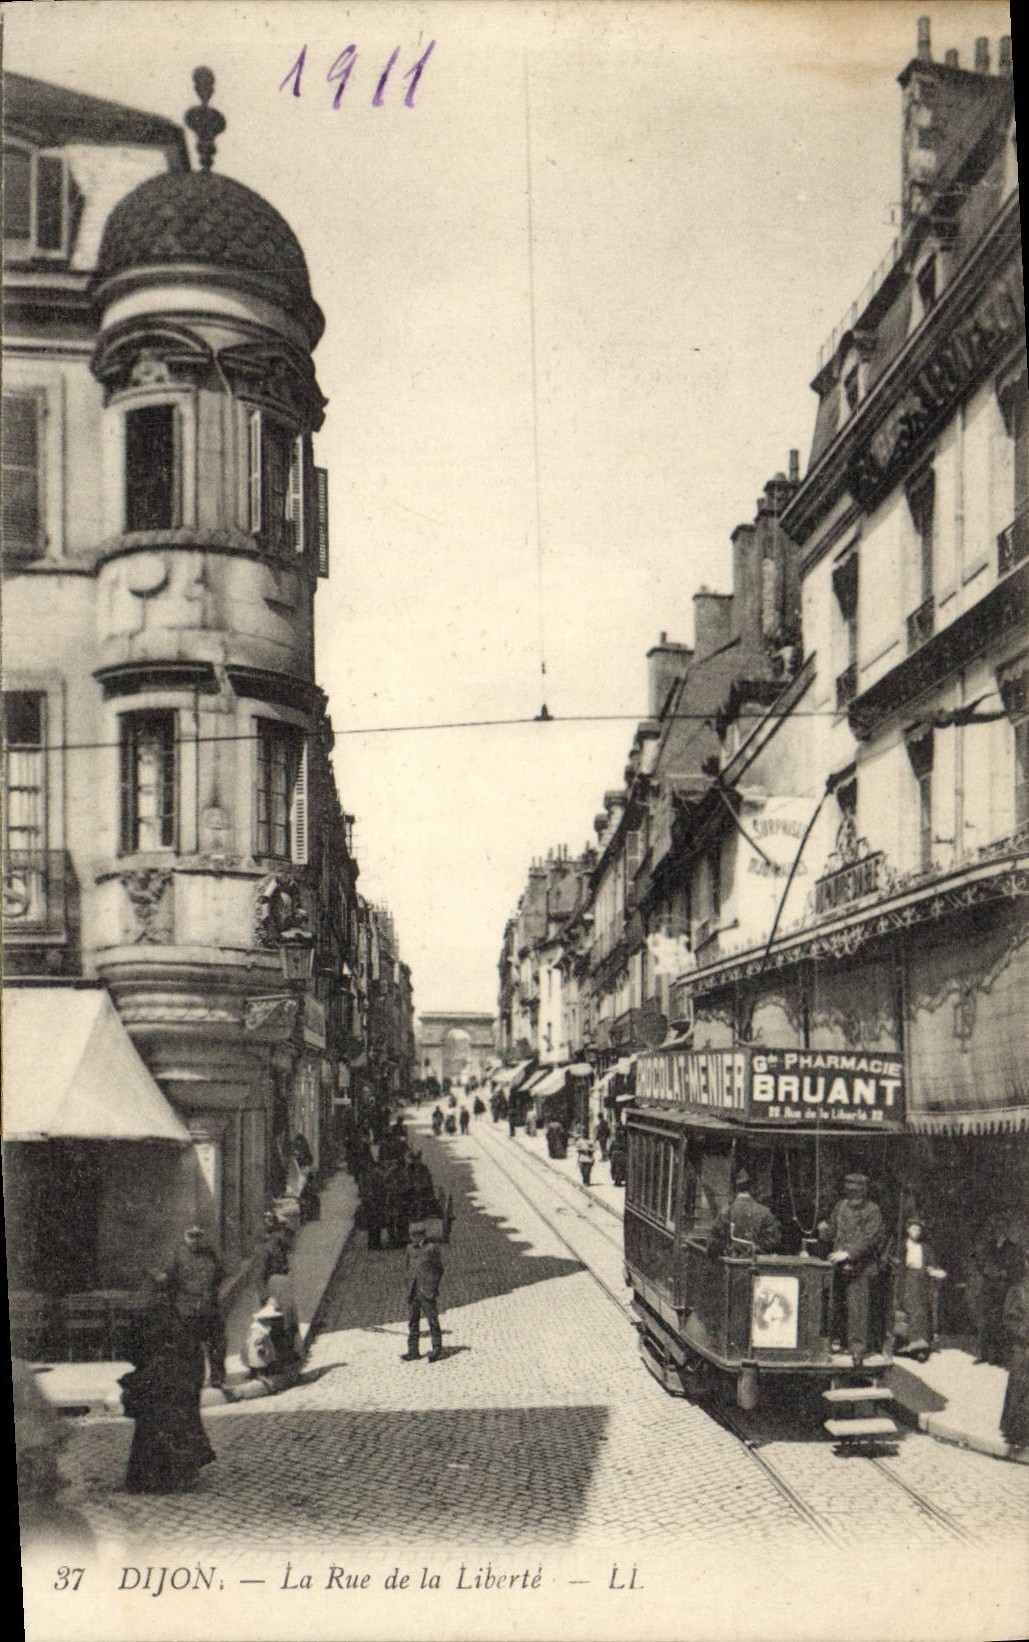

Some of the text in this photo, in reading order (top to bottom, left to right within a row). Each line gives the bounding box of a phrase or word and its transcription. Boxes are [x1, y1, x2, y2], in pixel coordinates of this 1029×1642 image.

[279, 39, 436, 110] 1911
[784, 1053, 902, 1077] PHARMACIE
[752, 1074, 902, 1107] BRUANT
